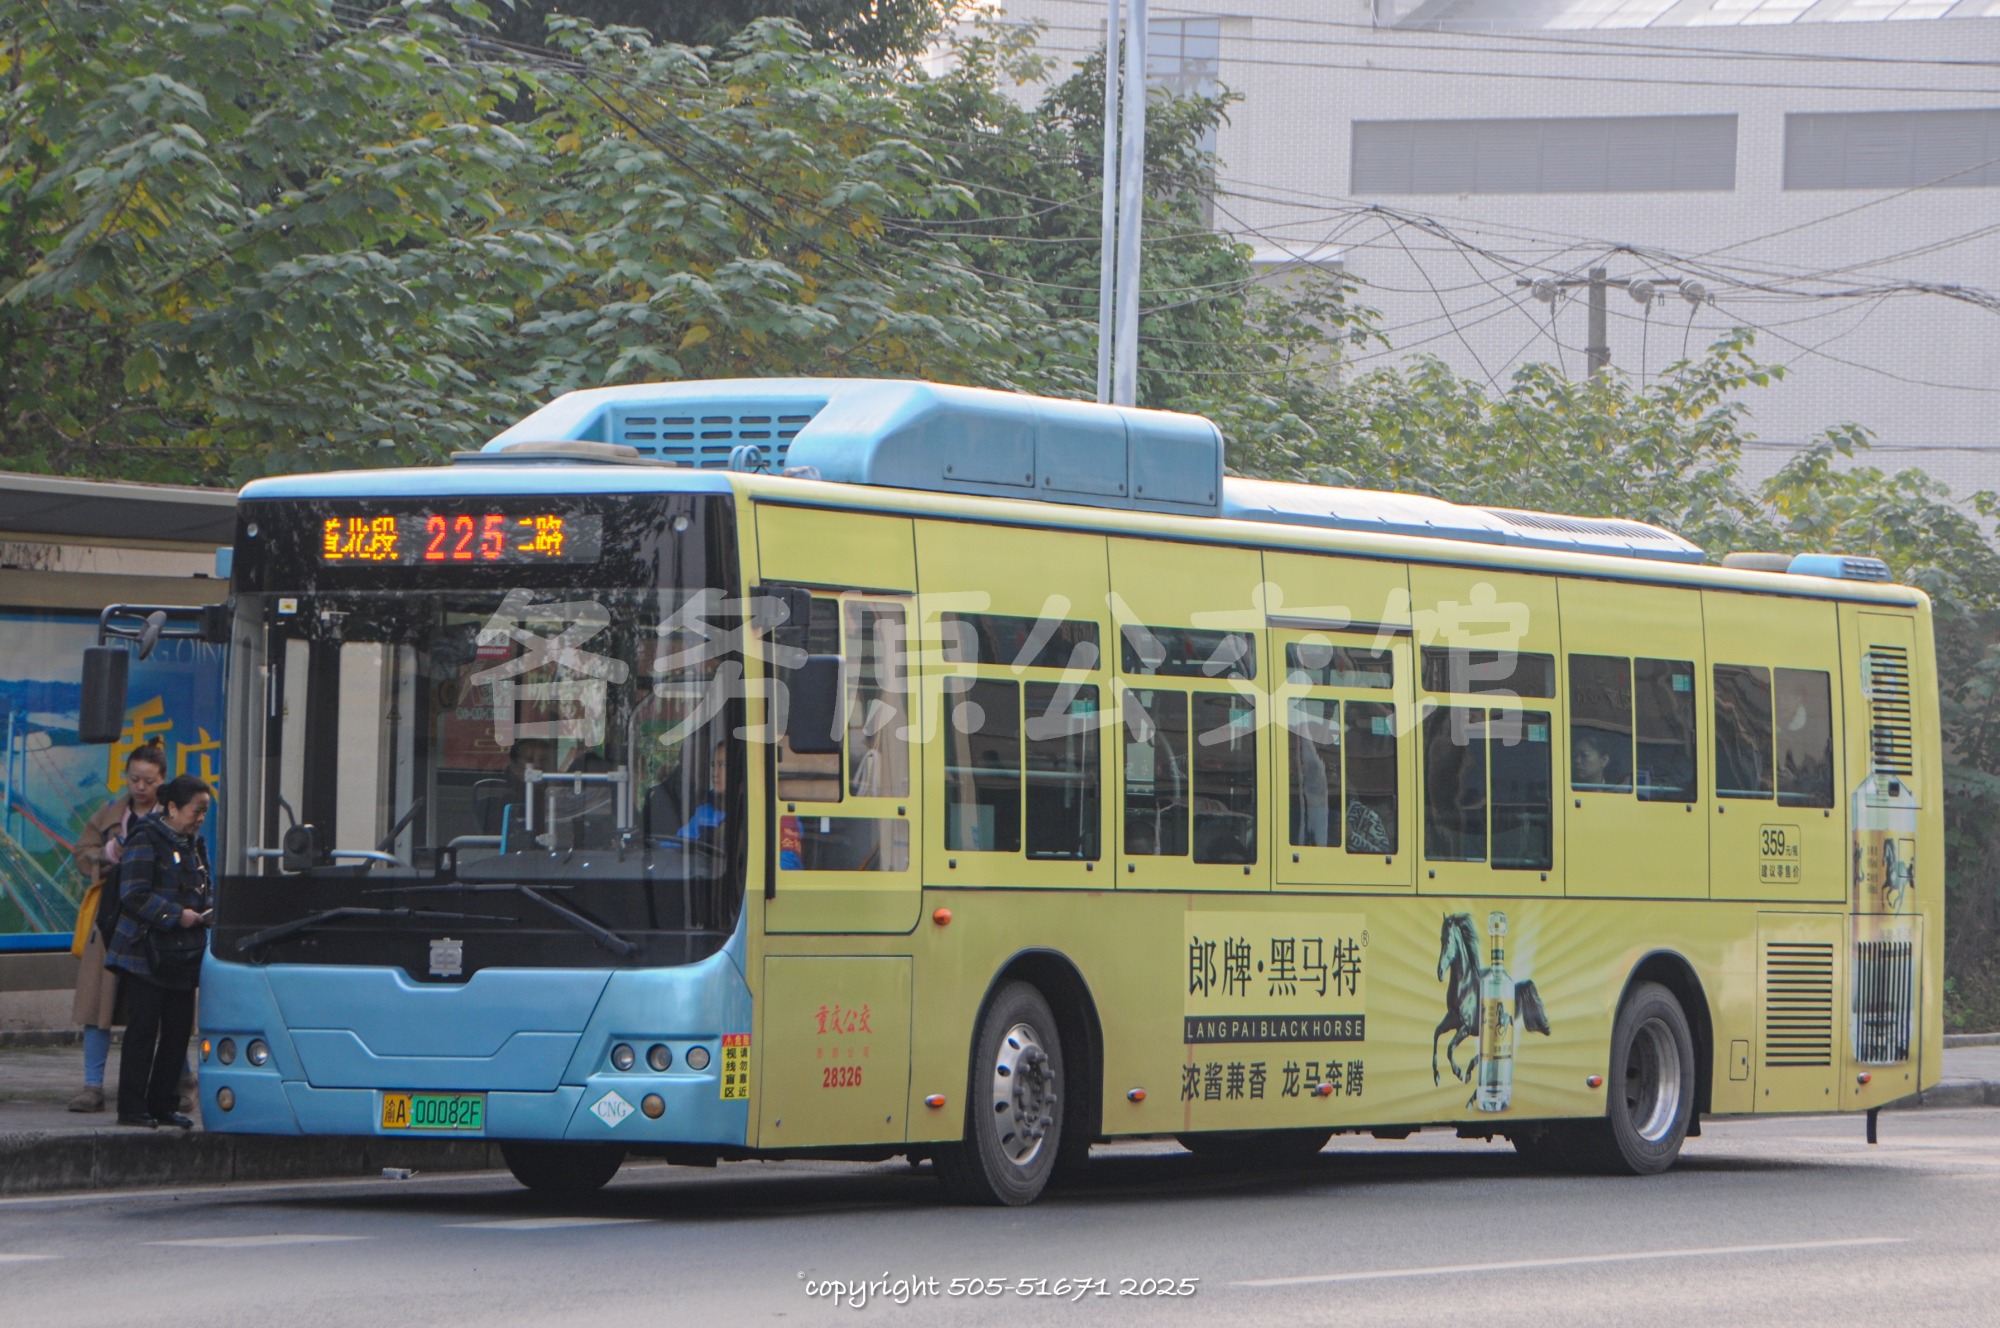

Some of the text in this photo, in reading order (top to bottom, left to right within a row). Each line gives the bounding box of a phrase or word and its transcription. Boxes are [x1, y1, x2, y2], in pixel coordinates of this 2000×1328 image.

[425, 515, 503, 559] 225
[1761, 864, 1799, 878] 建议零售价
[815, 1004, 872, 1035] 重庆公交
[1187, 1020, 1362, 1038] LANG PAI BLACK HORSE
[724, 1047, 737, 1098] 视线盲区
[738, 1047, 748, 1097] 请勿靠近
[822, 1066, 862, 1088] 28326
[1181, 1060, 1364, 1101] 浓酱兼香 龙马奔腾
[597, 1101, 626, 1117] CNG
